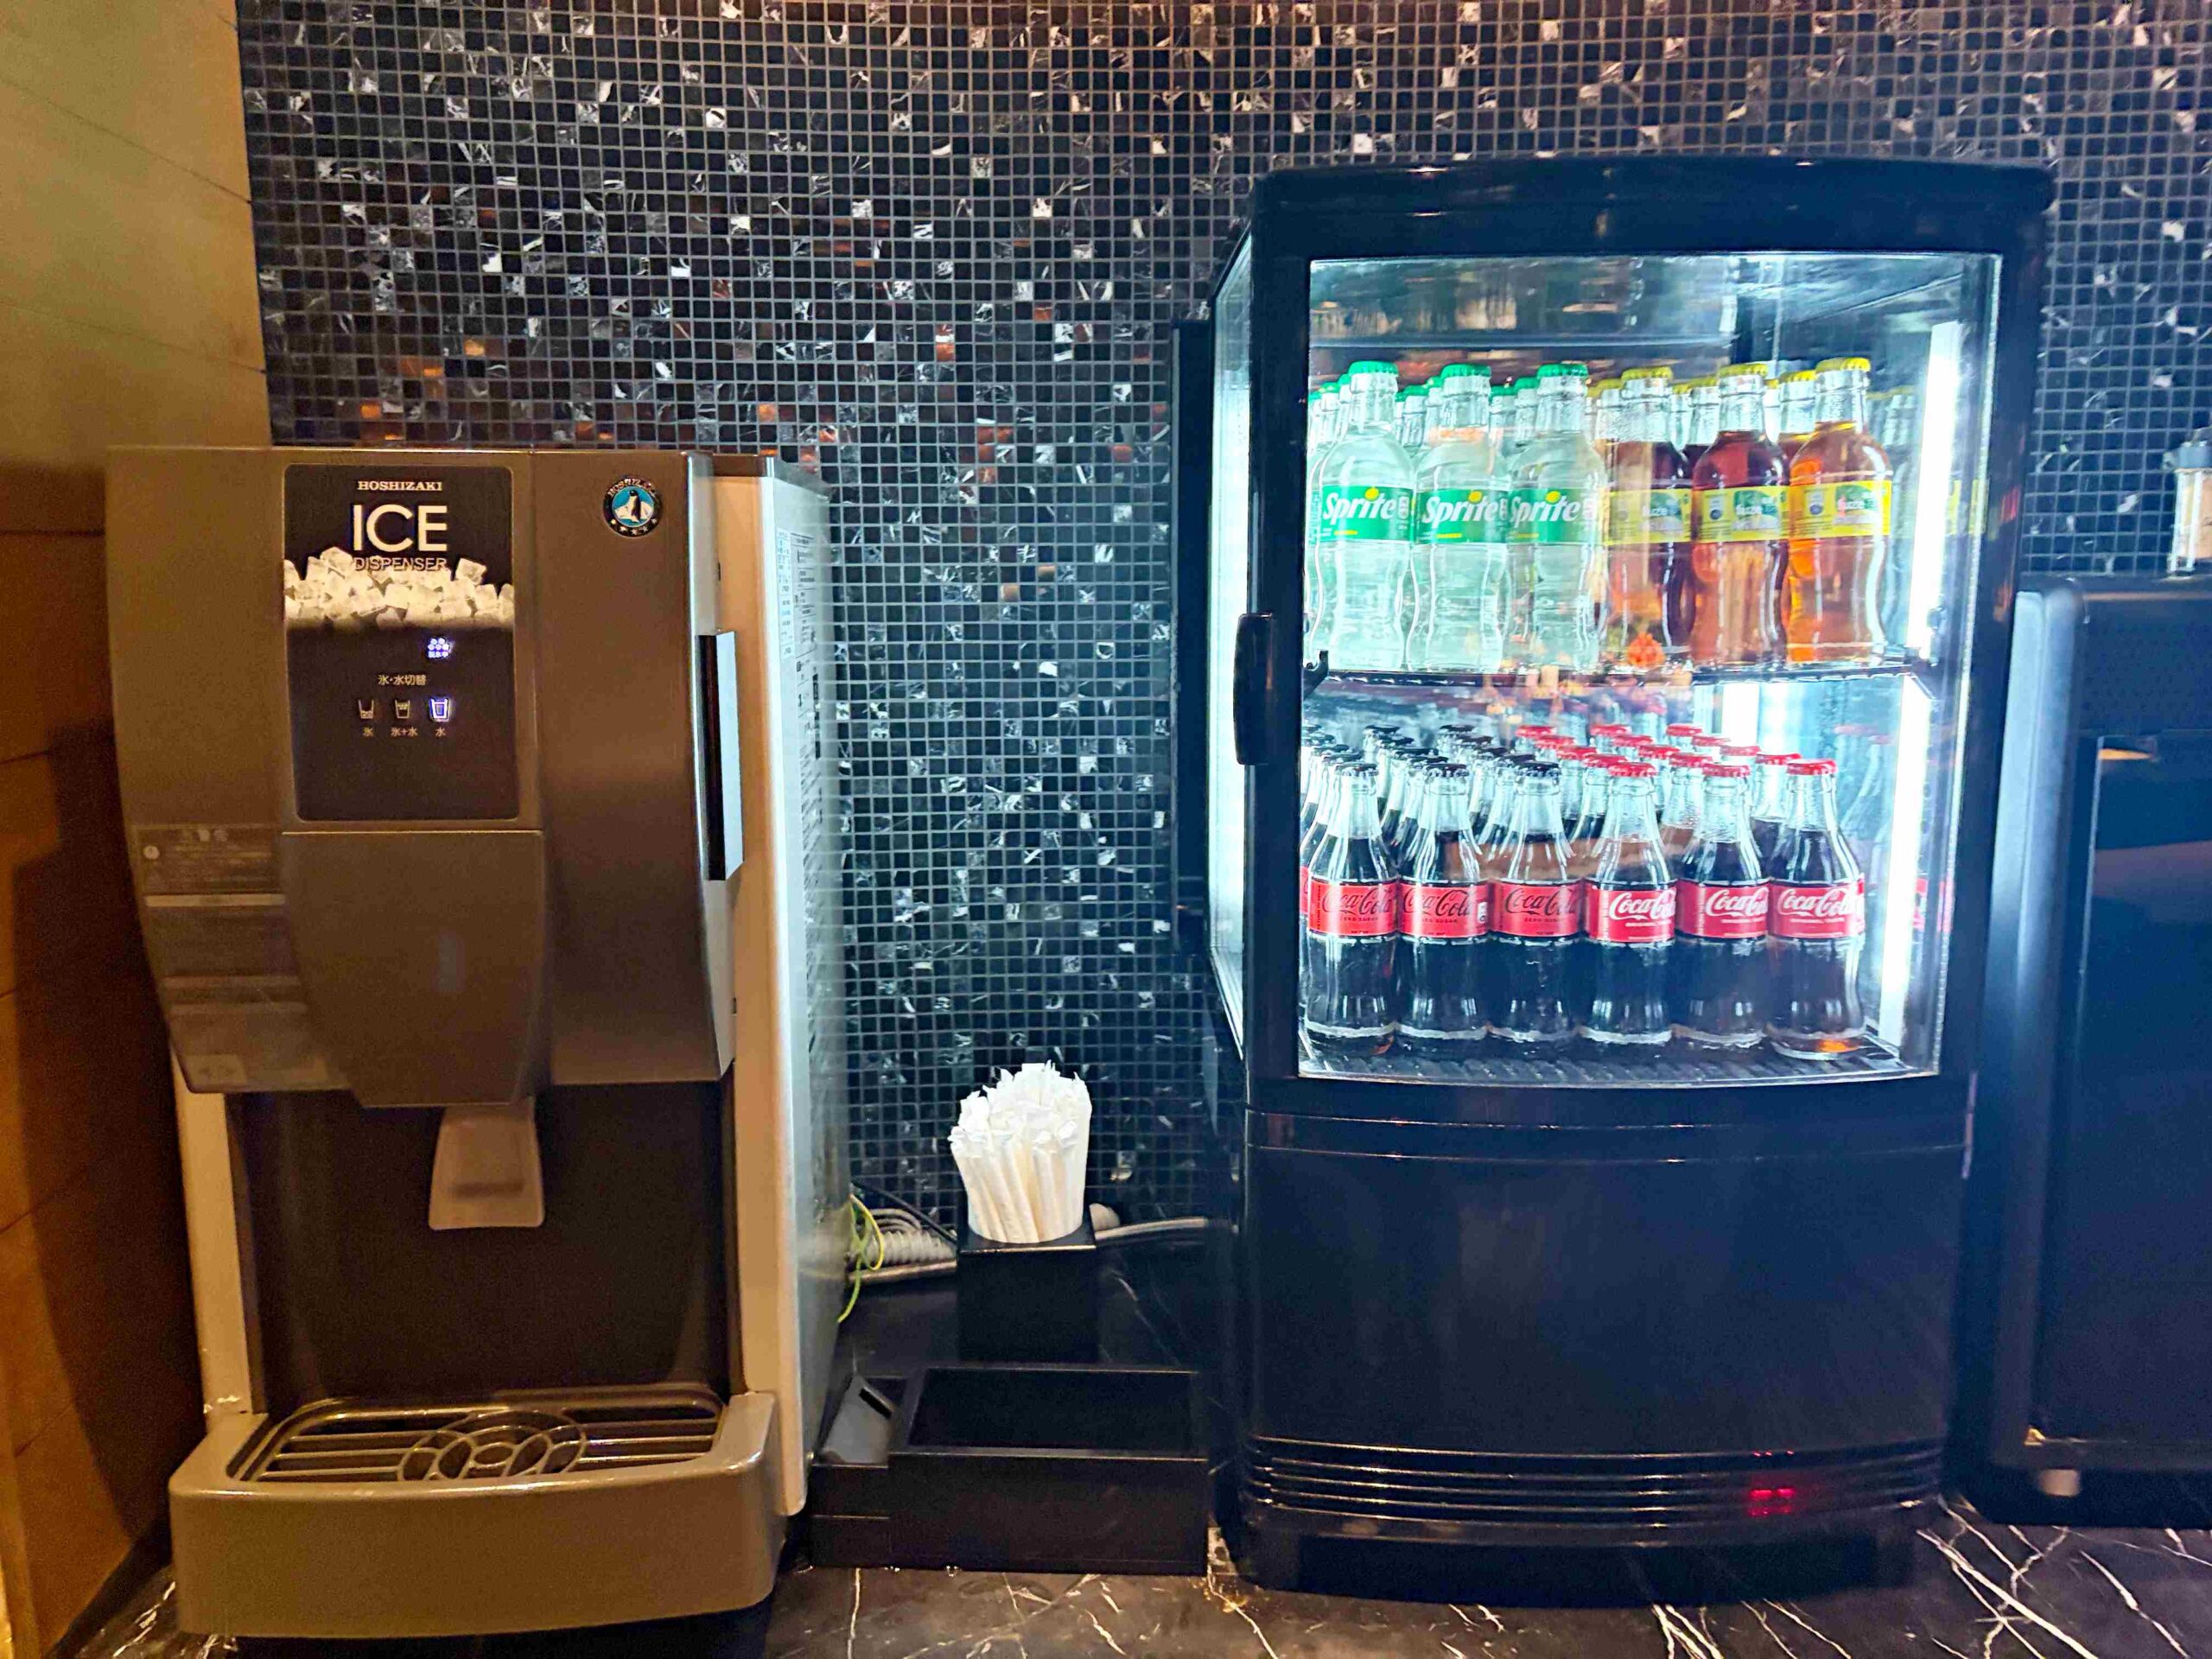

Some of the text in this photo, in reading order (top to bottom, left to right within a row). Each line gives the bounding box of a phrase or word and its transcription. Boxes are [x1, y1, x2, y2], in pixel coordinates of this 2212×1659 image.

[357, 480, 442, 492] HOSHIZAKI
[1323, 492, 1395, 525] Sprite
[1421, 495, 1498, 529] Sprite
[1510, 495, 1581, 528] Sprite
[353, 505, 448, 552] ICE
[354, 556, 448, 571] DISPENSER
[435, 727, 447, 737] 水
[1404, 887, 1474, 917] Cca-Cola
[1505, 887, 1575, 916] Coca-Cl
